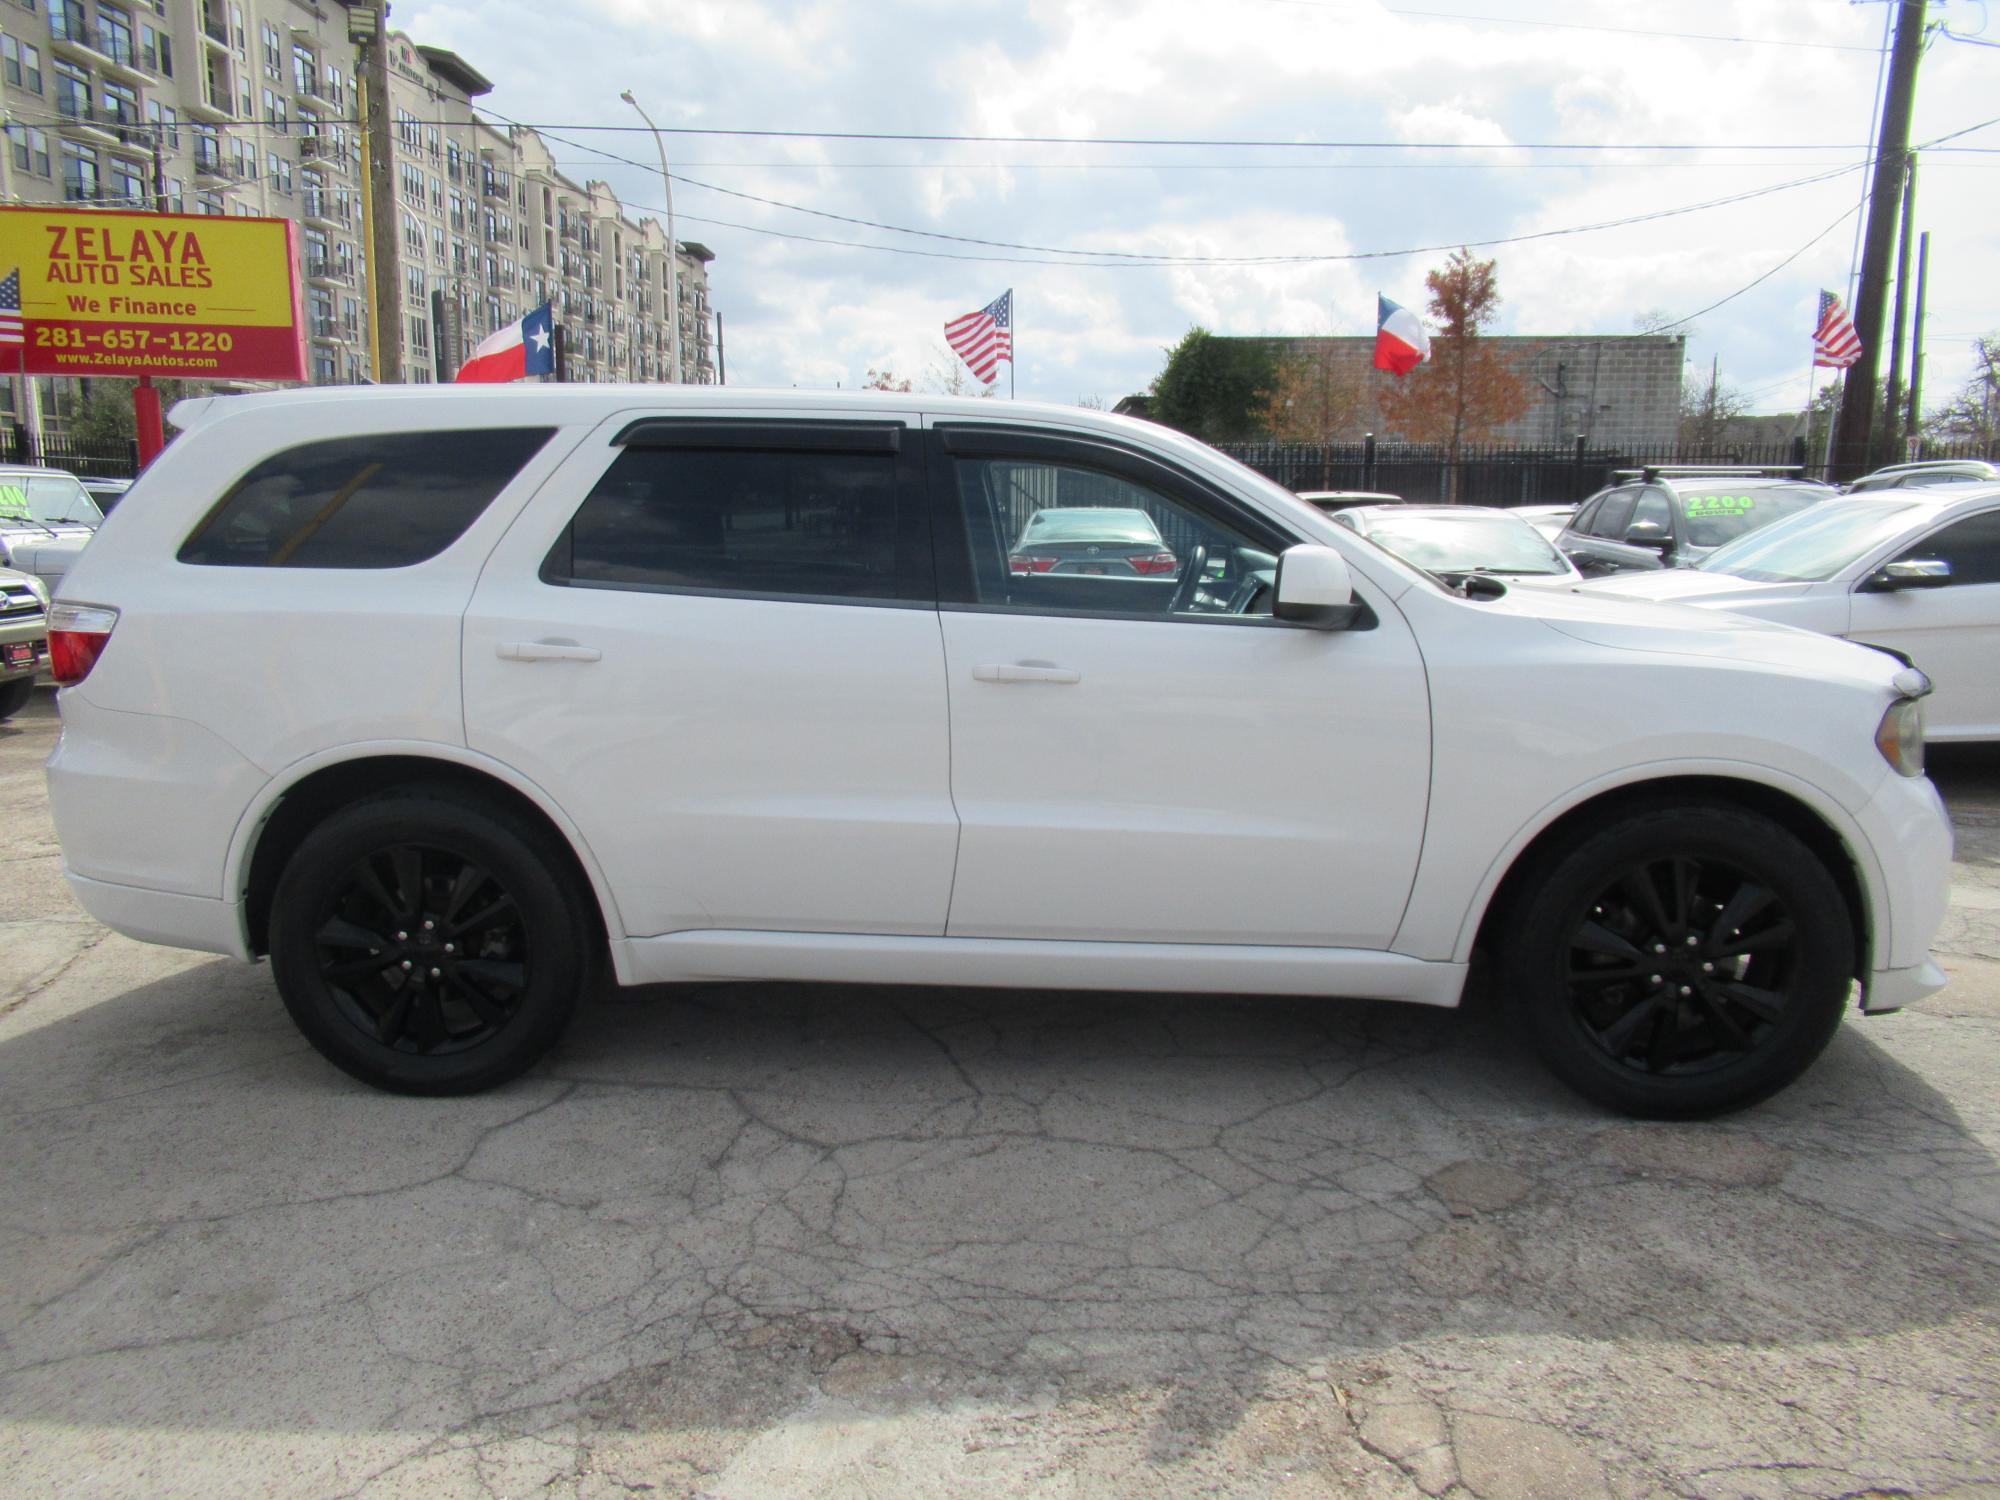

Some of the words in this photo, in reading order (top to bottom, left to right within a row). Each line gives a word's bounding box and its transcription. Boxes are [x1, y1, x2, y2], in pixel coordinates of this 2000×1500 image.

[46, 226, 205, 265] ZELAYA
[47, 262, 119, 285] AUTO
[130, 266, 213, 288] SALES
[67, 295, 100, 313] We
[110, 297, 196, 316] Finance
[36, 327, 233, 352] 281-657-1220
[56, 352, 217, 368] www.ZelayaAutos.com
[0, 485, 28, 506] 00
[1688, 495, 1755, 510] 2200
